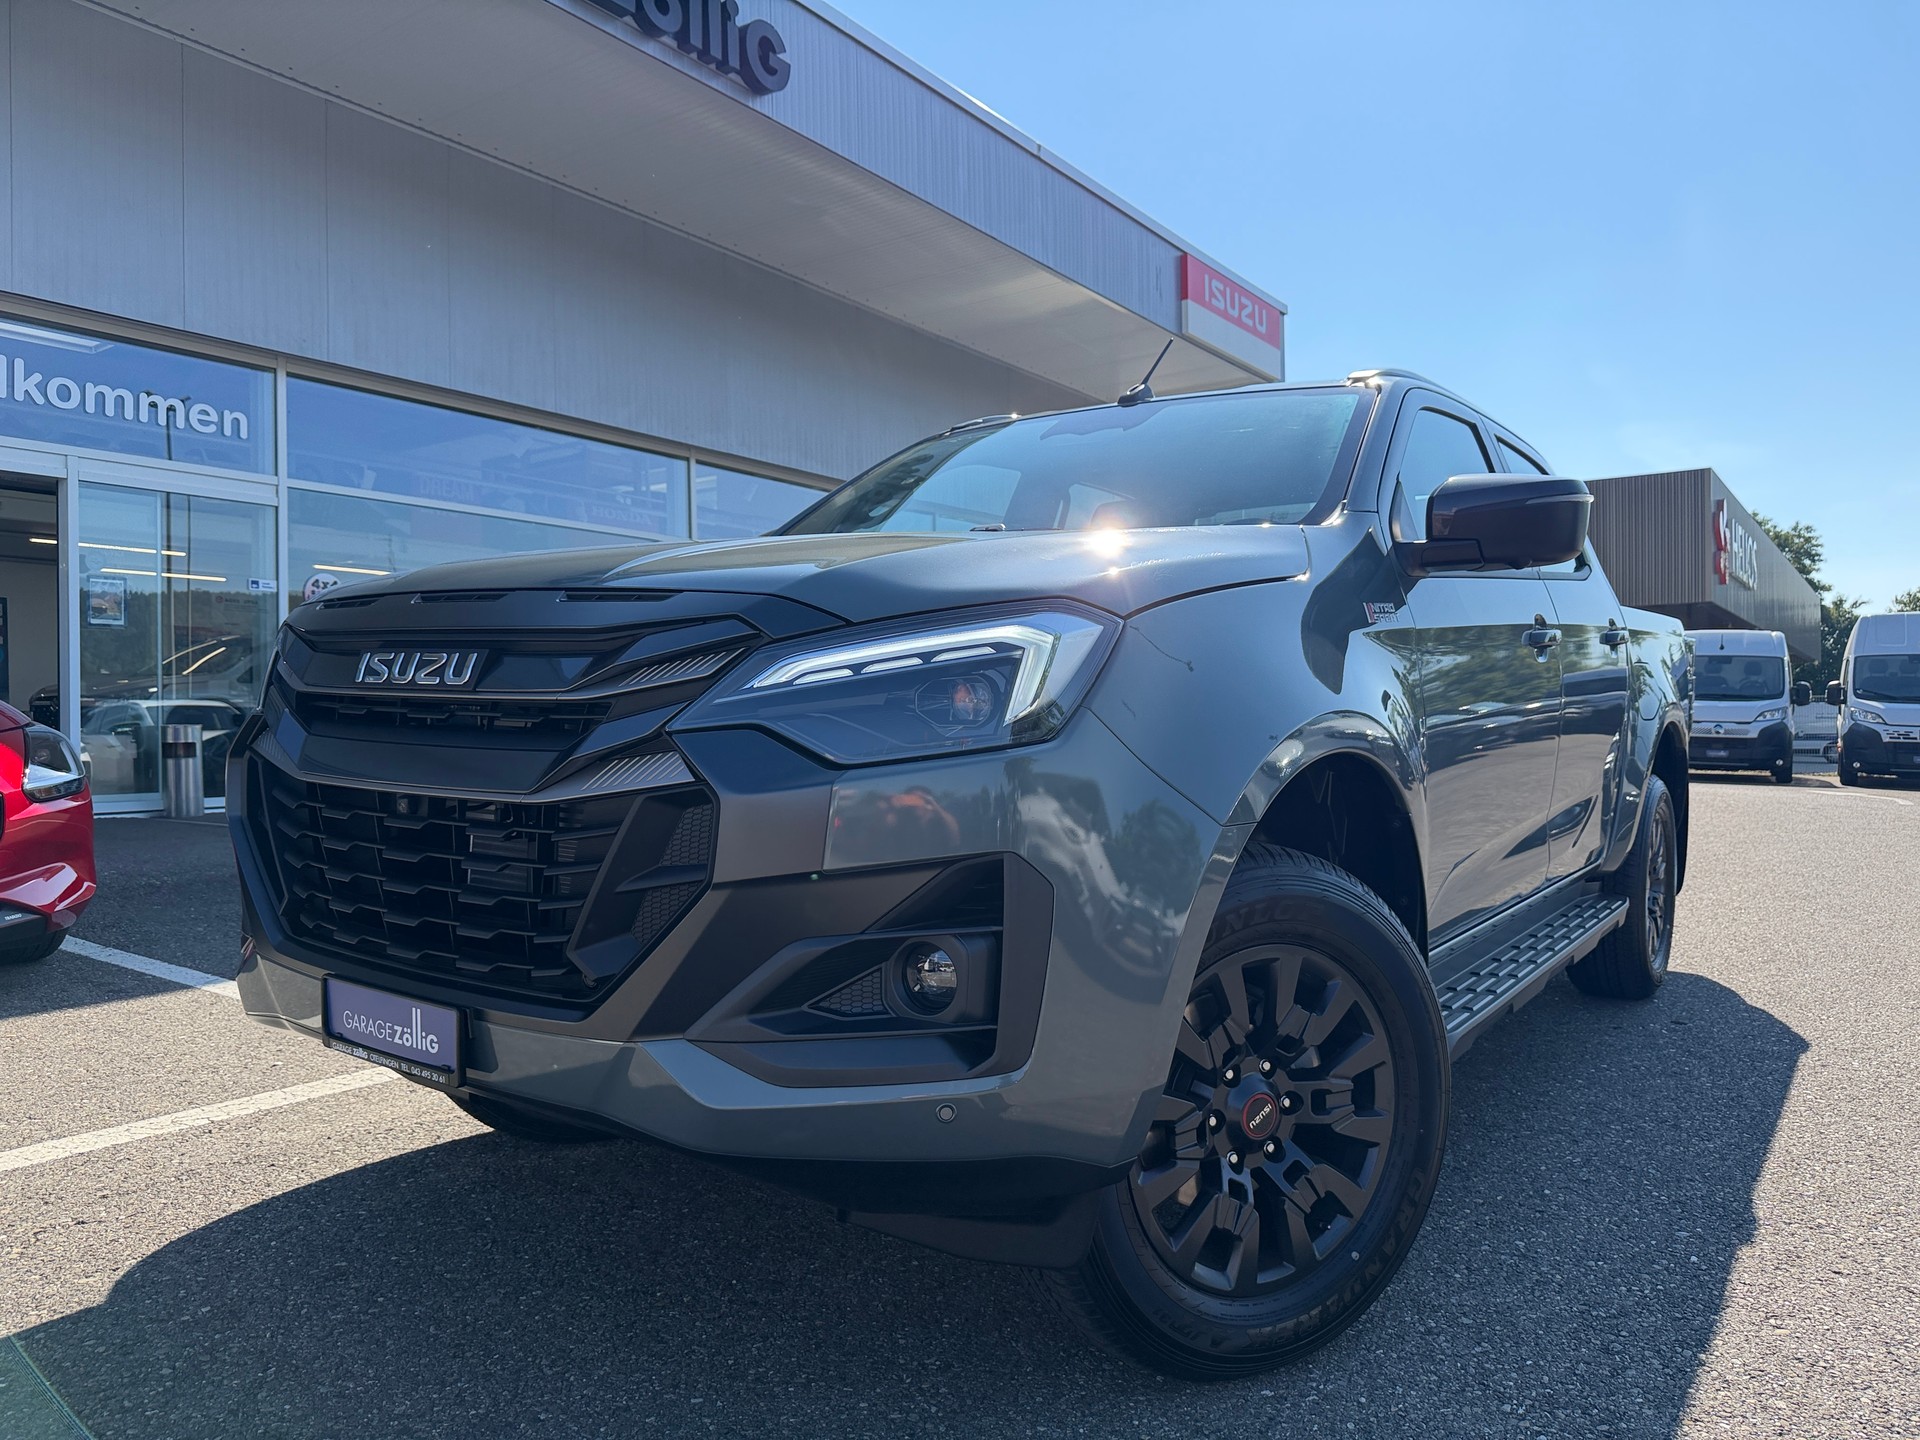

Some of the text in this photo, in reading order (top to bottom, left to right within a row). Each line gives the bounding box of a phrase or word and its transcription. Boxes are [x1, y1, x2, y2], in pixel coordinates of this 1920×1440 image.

[1204, 273, 1267, 335] ISUZU
[1732, 518, 1758, 591] HELIOS
[1368, 602, 1396, 613] NITRO
[355, 652, 478, 685] ISUZU
[332, 1042, 353, 1055] GARAGE
[1248, 1103, 1273, 1129] ISUZU
